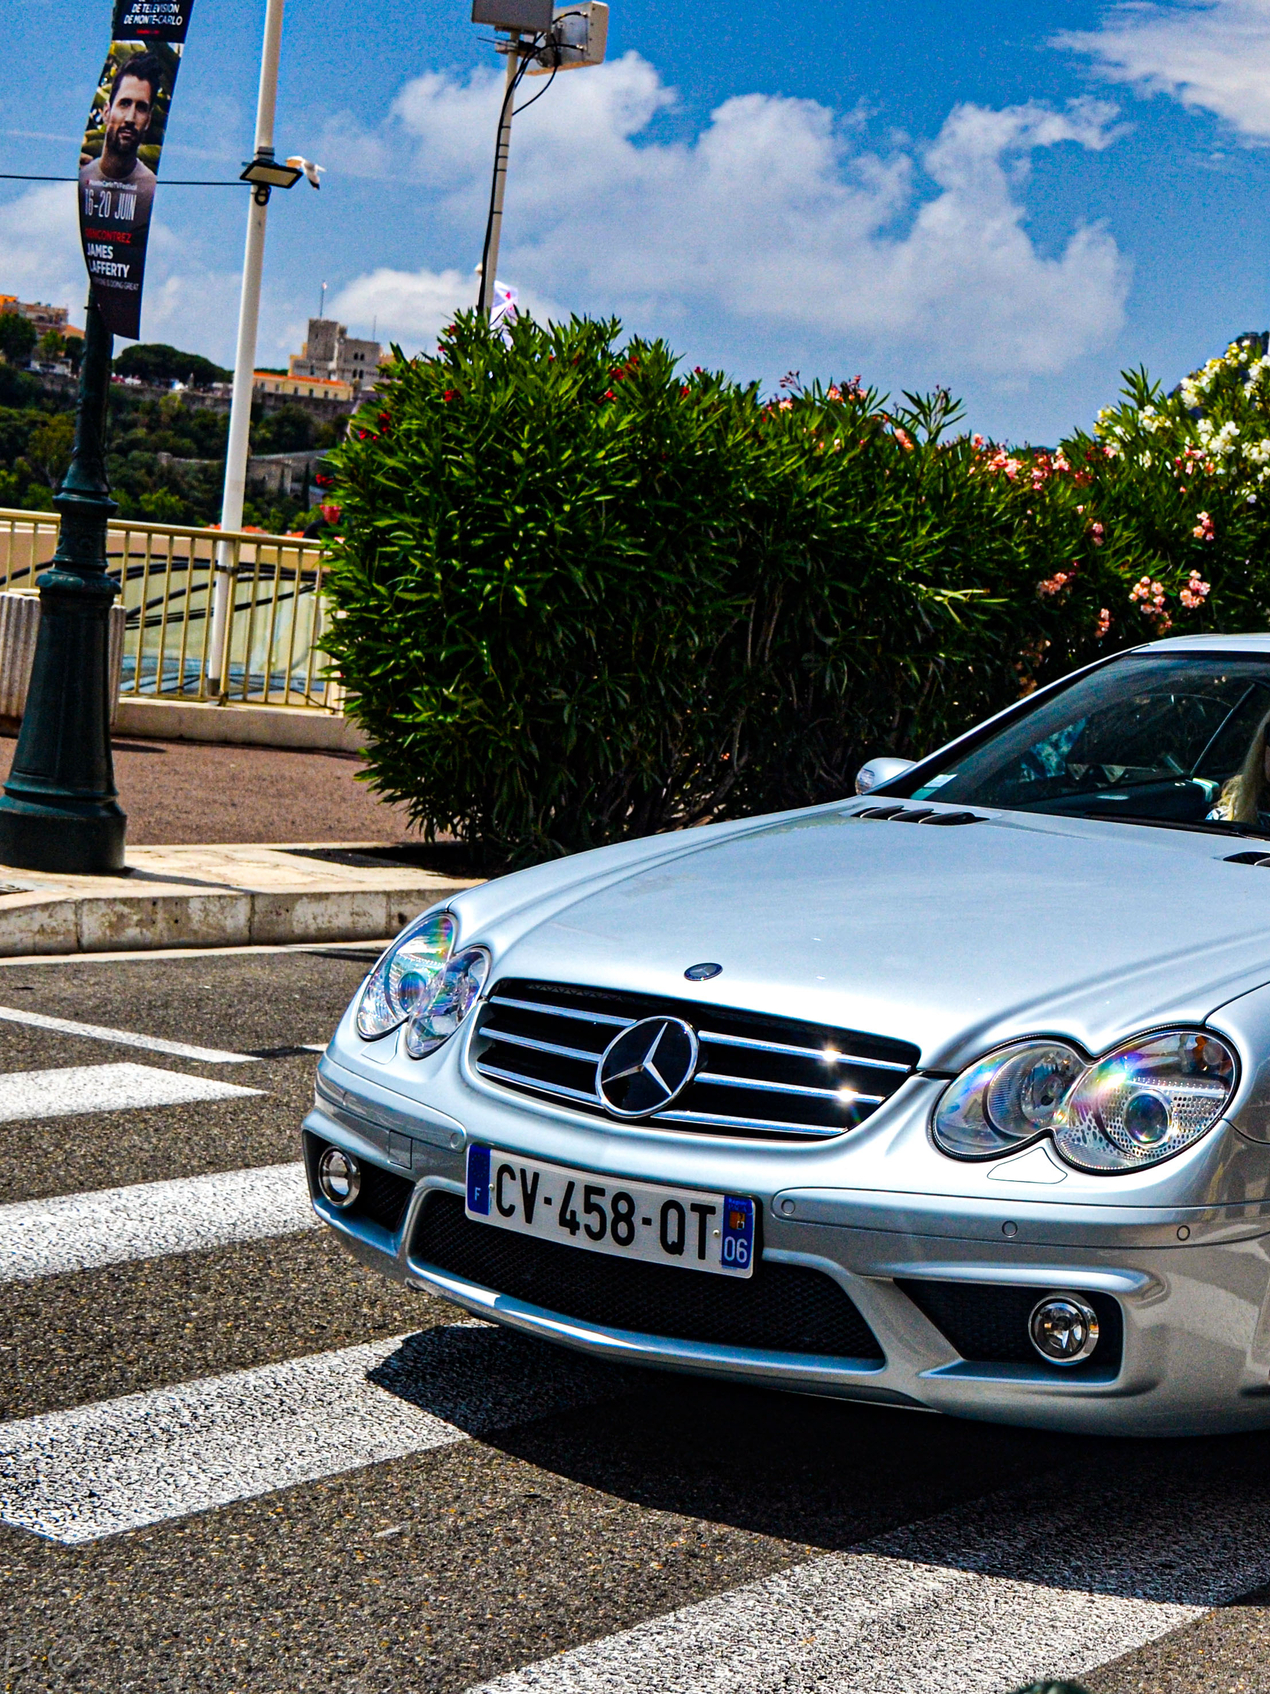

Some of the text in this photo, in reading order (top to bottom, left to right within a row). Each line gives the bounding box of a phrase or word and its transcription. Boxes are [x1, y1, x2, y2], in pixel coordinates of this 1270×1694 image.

[132, 4, 142, 13] DE
[124, 14, 183, 26] DE MONTE-CARLO
[85, 189, 137, 221] 16-20 JUIN
[87, 243, 114, 260] JAMES
[88, 260, 130, 278] LAFFERTY
[474, 1187, 481, 1201] F
[495, 1163, 716, 1261] CV-458-QT
[724, 1235, 748, 1263] 06
